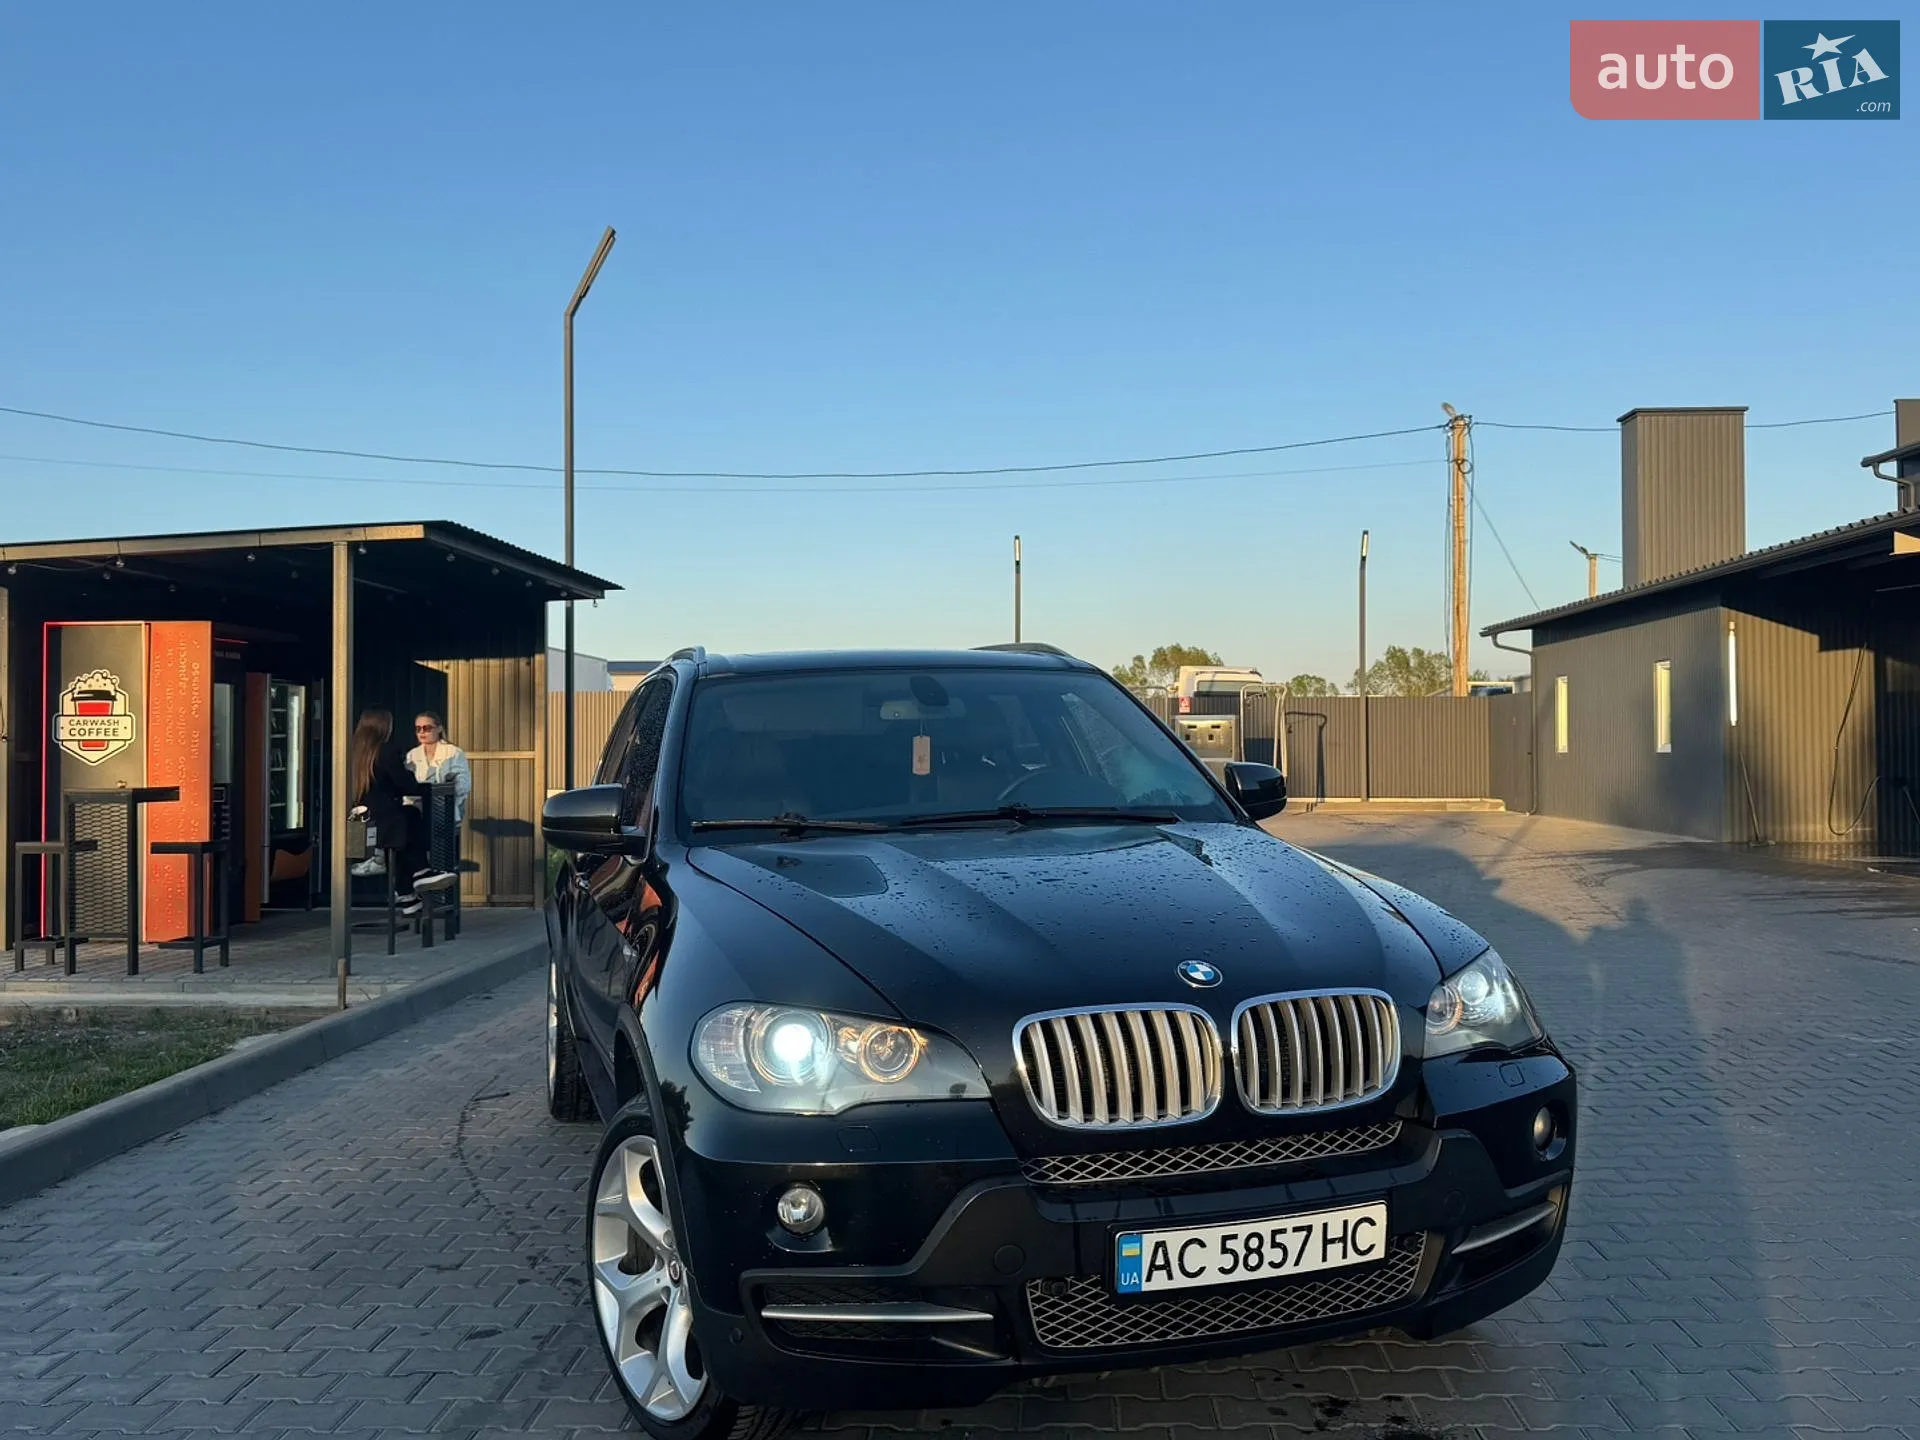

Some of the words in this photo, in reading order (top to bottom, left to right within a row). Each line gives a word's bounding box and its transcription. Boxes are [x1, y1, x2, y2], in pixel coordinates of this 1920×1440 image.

[69, 728, 119, 737] COFFEE
[1145, 1237, 1206, 1283] AC
[1218, 1225, 1313, 1276] 5857
[1321, 1216, 1377, 1263] HC
[1121, 1272, 1140, 1286] UA
